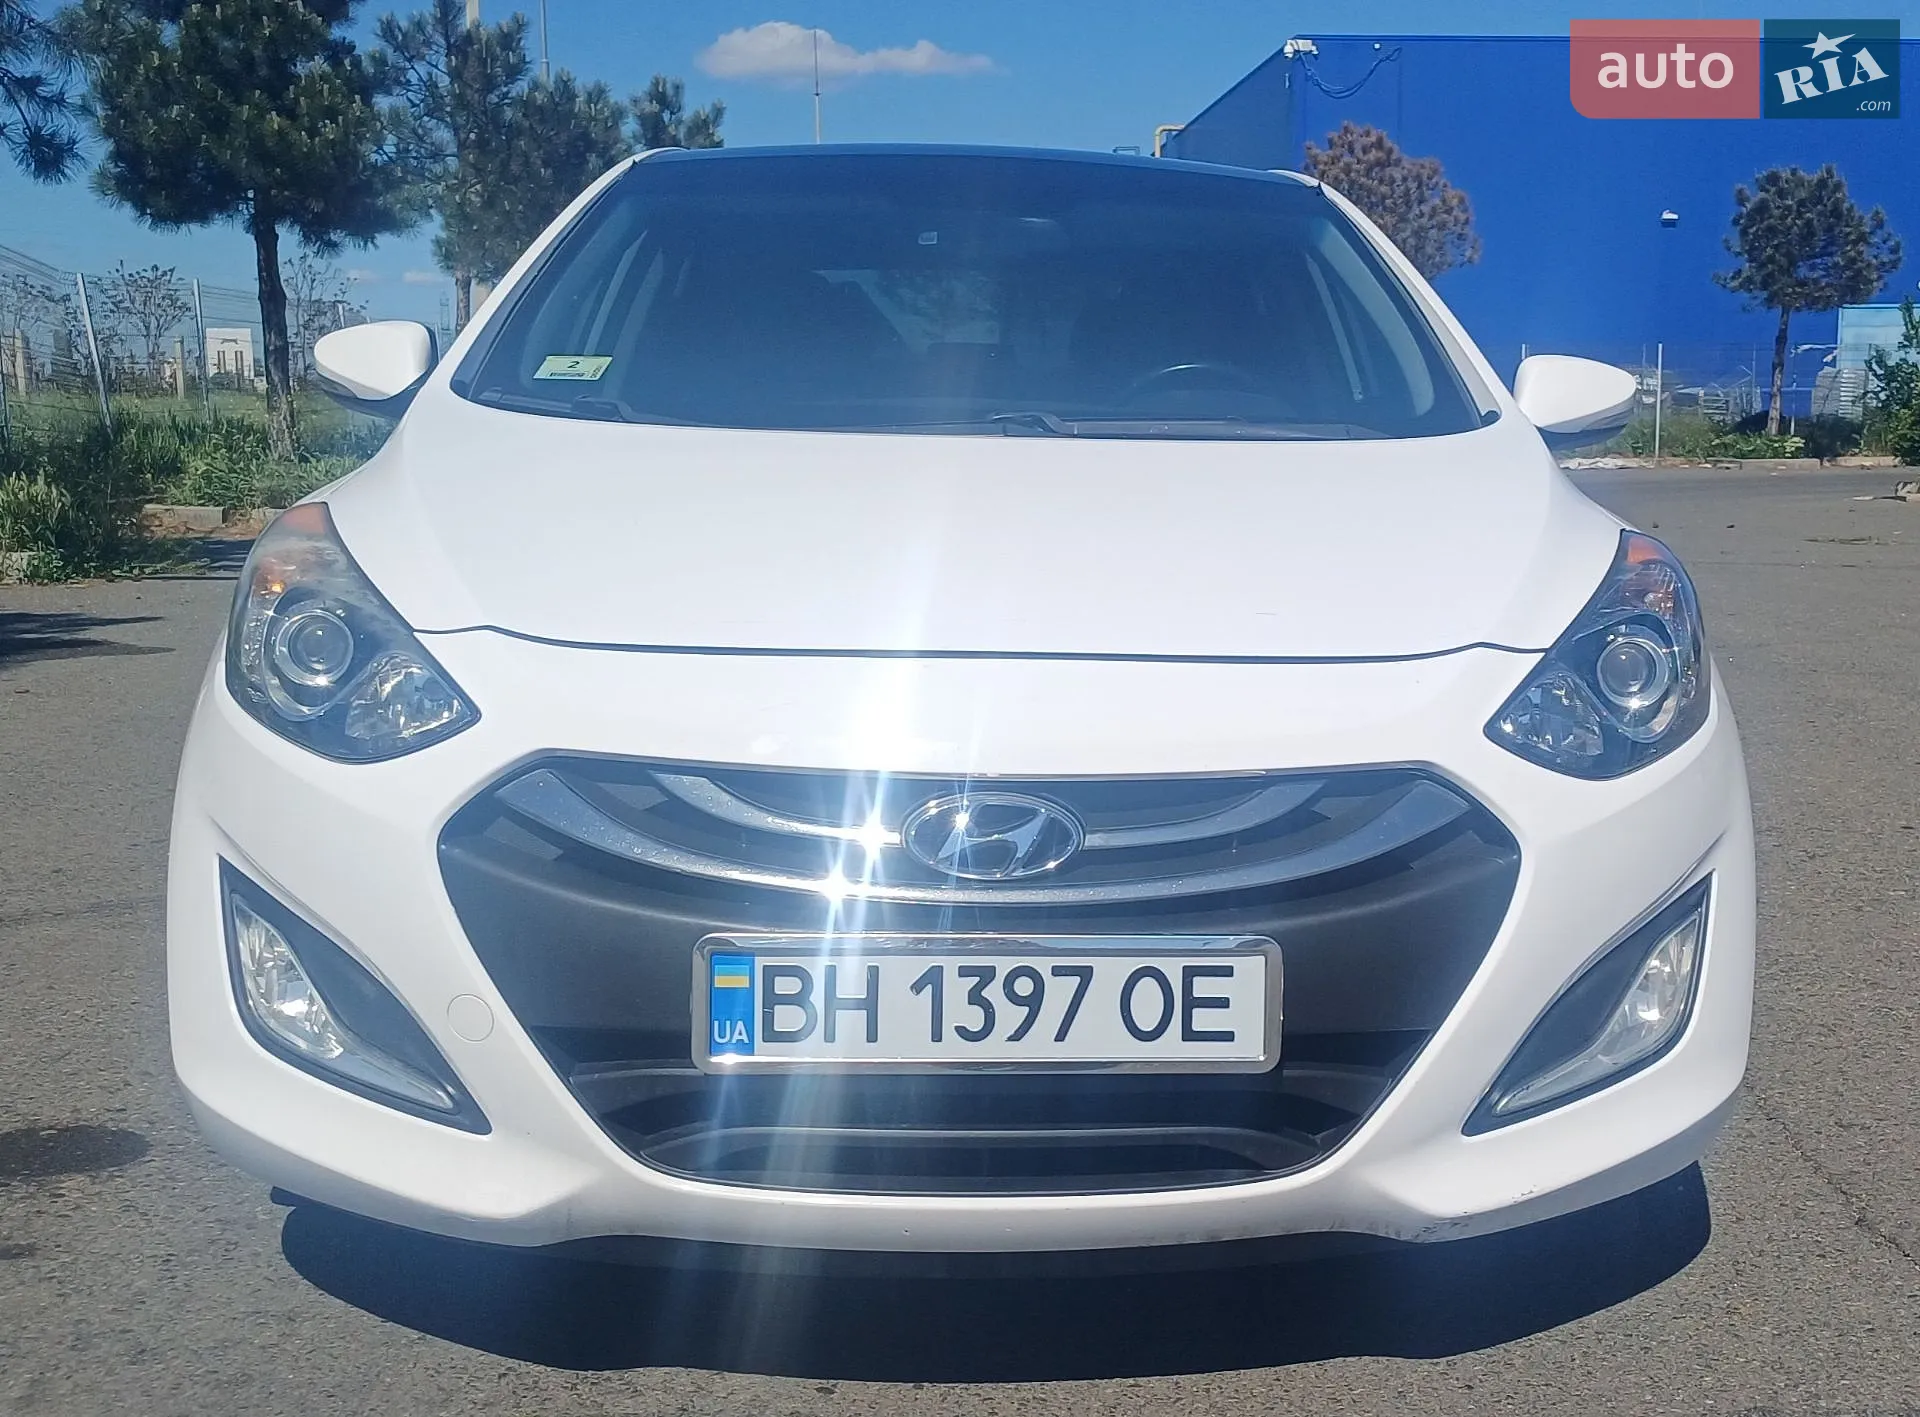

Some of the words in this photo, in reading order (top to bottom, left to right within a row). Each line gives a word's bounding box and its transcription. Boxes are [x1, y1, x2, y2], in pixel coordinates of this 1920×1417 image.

[567, 361, 580, 369] 2
[761, 964, 880, 1042] BH
[909, 964, 1094, 1042] 1397
[1119, 964, 1235, 1042] OE
[713, 1018, 750, 1044] UA
